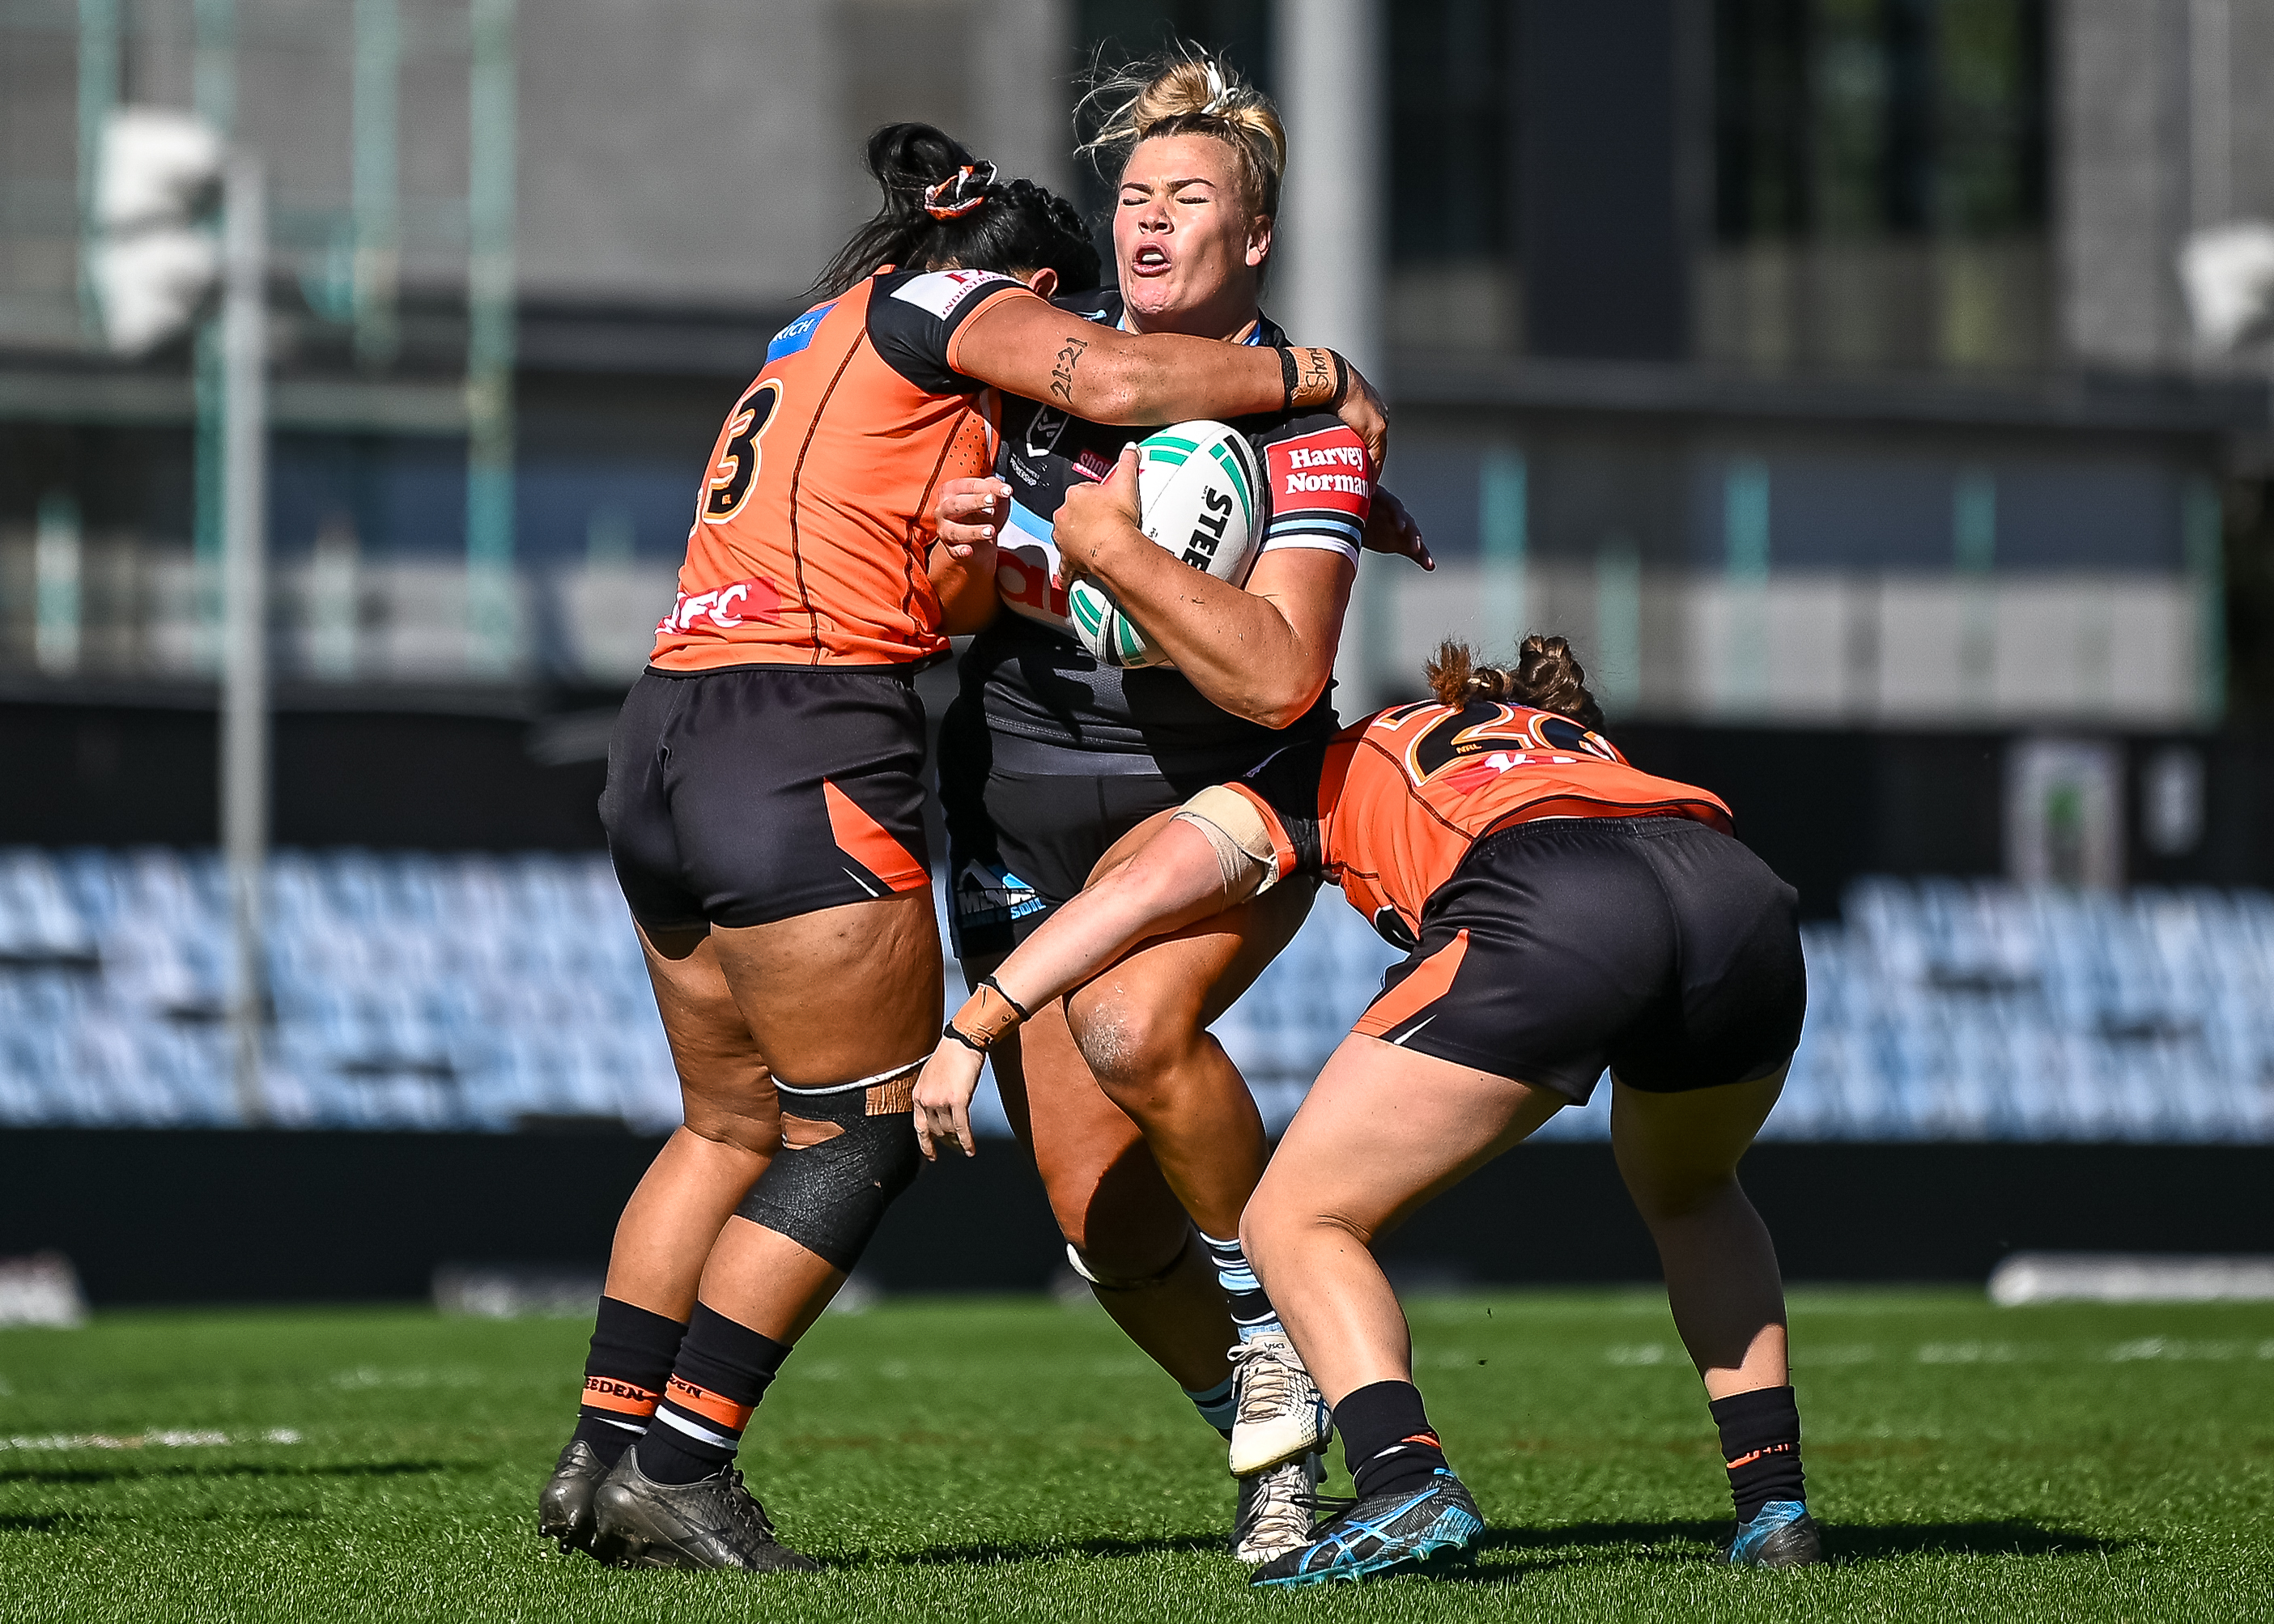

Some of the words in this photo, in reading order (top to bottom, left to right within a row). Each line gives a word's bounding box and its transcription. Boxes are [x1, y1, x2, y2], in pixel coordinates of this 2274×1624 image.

[1050, 337, 1088, 404] 21:21
[1288, 447, 1363, 472] Harvey
[1285, 472, 1369, 499] Norman
[1456, 742, 1482, 755] NRL
[1009, 896, 1047, 920] SOIL
